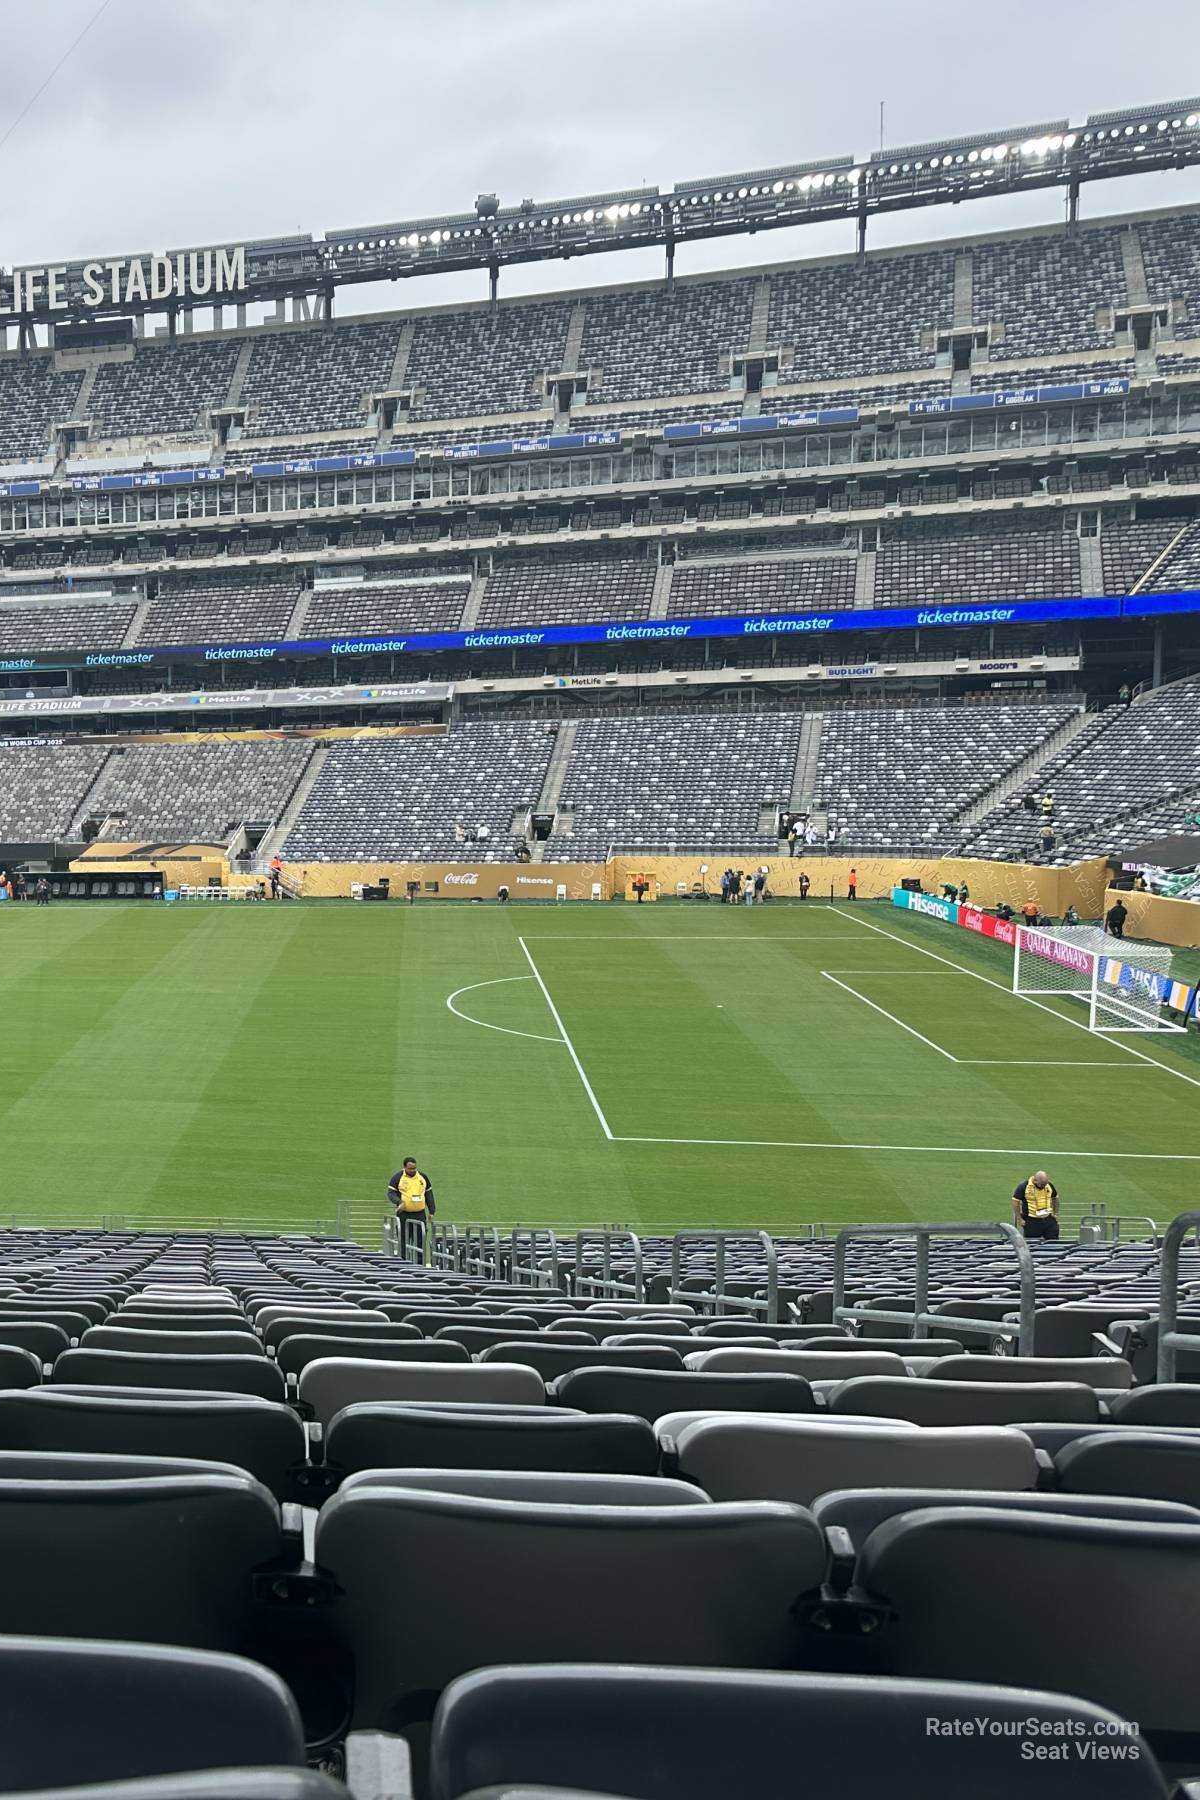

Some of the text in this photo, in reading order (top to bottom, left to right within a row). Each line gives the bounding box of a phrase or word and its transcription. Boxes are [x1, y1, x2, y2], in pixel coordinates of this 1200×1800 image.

[82, 247, 245, 306] STADIUM
[917, 608, 1015, 624] ticketmaster
[743, 618, 834, 632] ticketmaster
[606, 625, 691, 639] ticketmaster
[464, 632, 545, 647] ticketmaster
[205, 647, 276, 660] ticketmaster
[330, 641, 406, 654] ticketmaster
[86, 653, 154, 665] ticketmaster
[828, 667, 874, 676] BUD LIGHT
[980, 662, 1018, 670] MOODY'S
[208, 695, 251, 703] MetLife
[381, 688, 427, 697] MetLife
[28, 701, 82, 711] STADIUM
[516, 876, 553, 885] Hisense
[908, 891, 949, 921] Hisense
[1026, 932, 1089, 970] QATAR AIRWAYS
